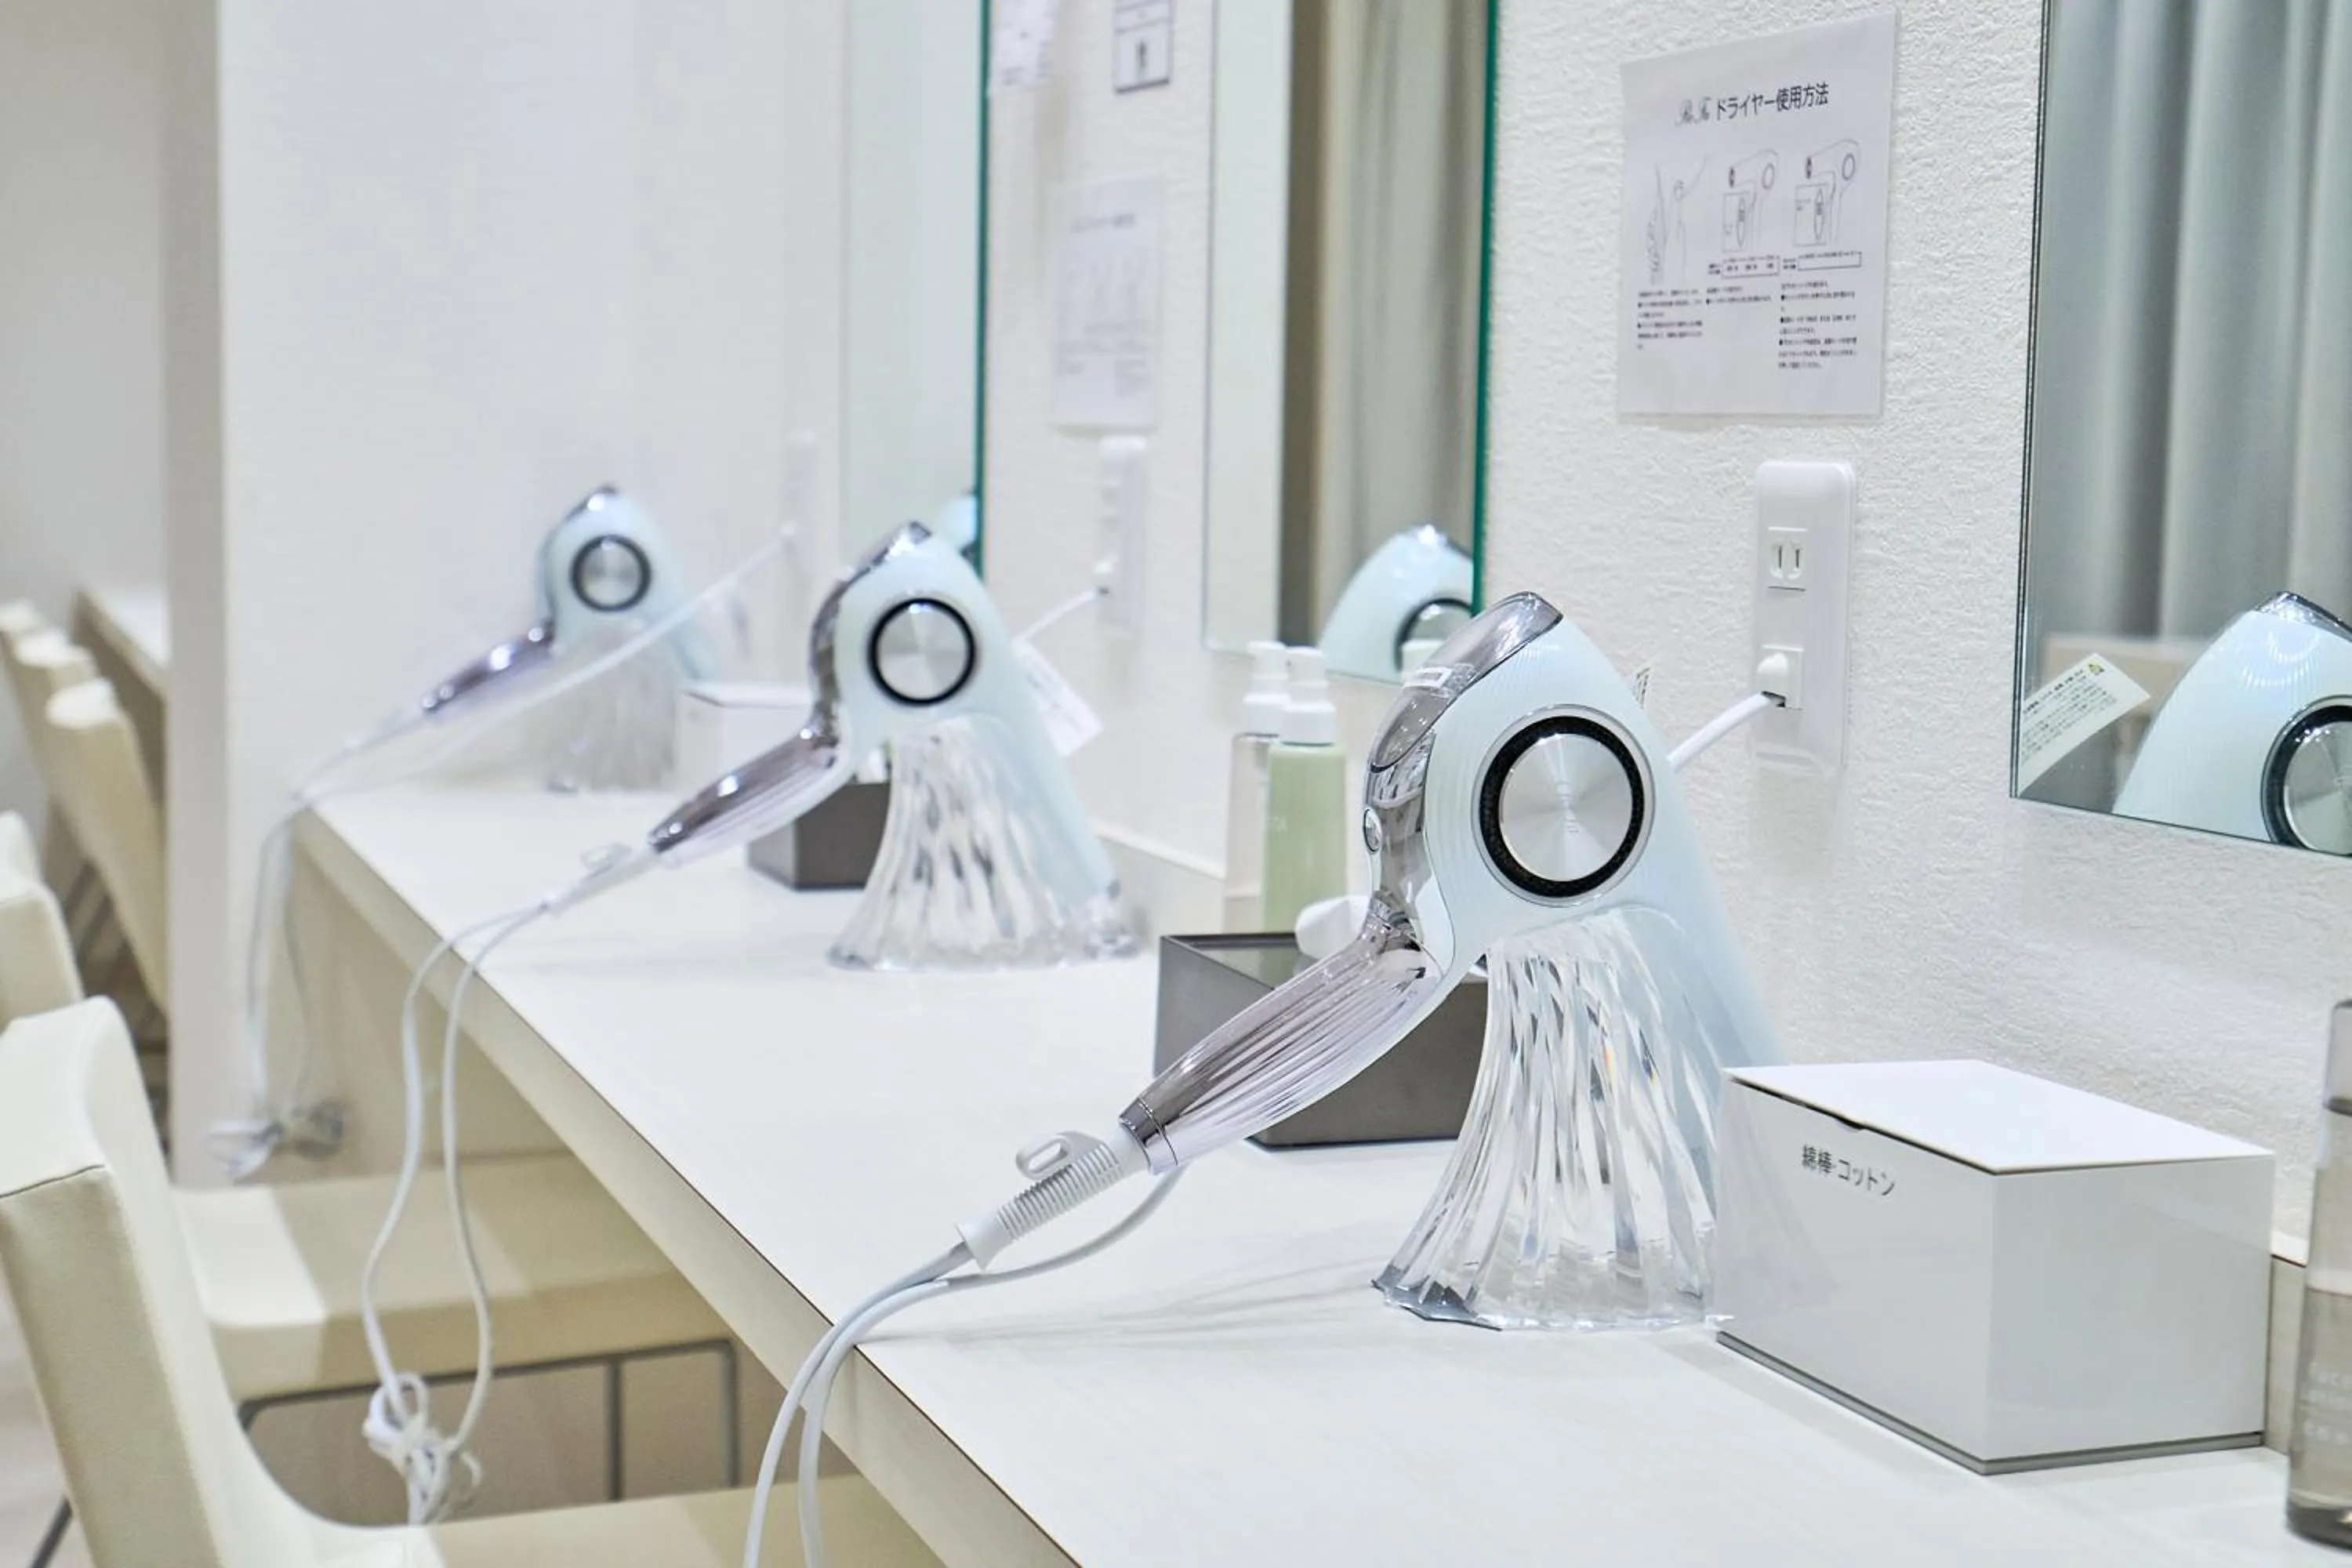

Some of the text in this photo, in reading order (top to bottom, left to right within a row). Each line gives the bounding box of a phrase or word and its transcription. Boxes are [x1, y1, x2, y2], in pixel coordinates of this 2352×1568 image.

[1717, 82, 1828, 121] ドライヤー使用方法
